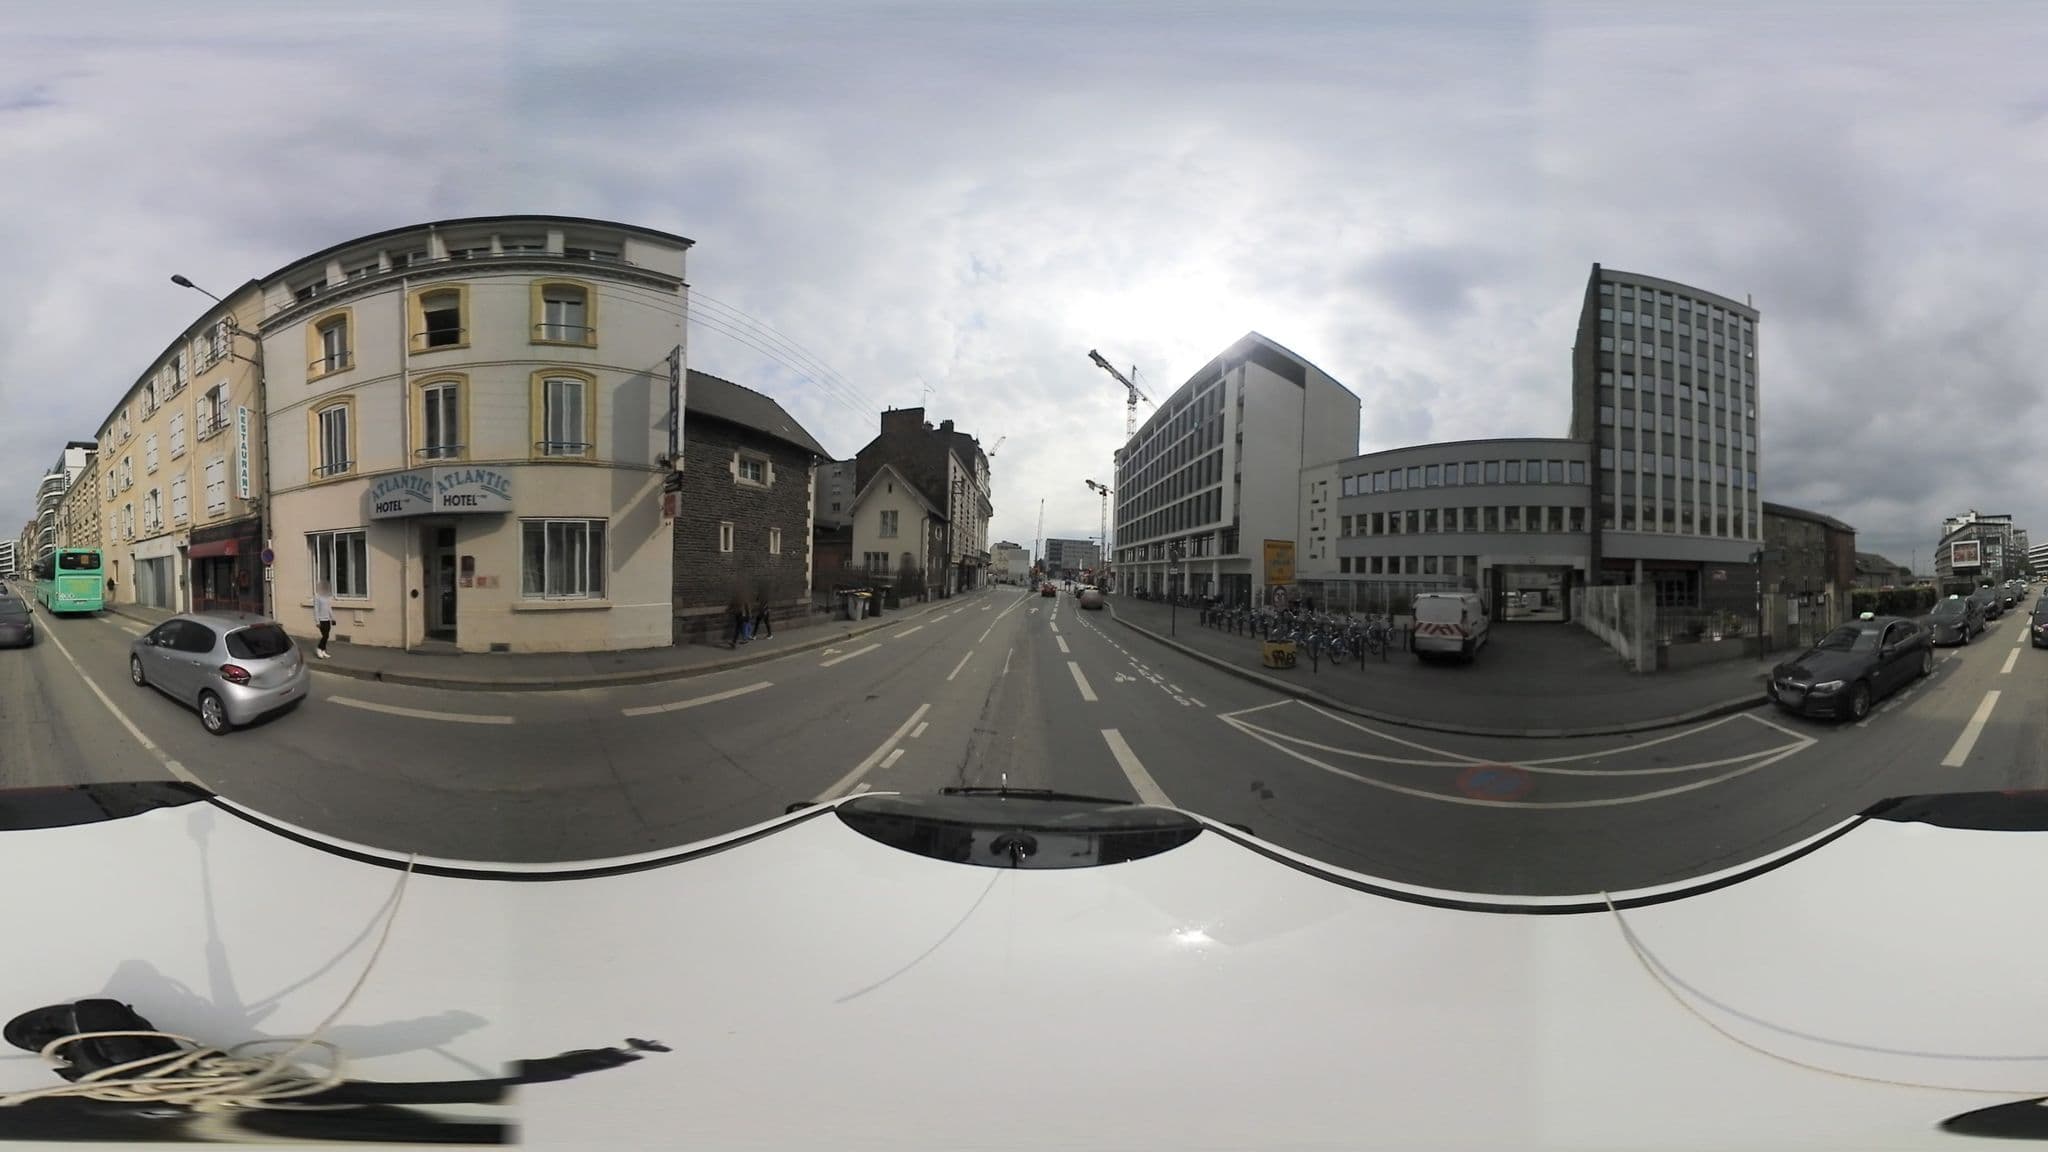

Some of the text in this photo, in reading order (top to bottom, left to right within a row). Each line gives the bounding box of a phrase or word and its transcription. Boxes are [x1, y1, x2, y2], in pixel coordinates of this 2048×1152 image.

[670, 349, 679, 456] HOTEL
[239, 407, 249, 497] RESTAURANT
[371, 474, 433, 502] ATLANTIC
[435, 469, 512, 494] ATLANTIC
[375, 499, 403, 513] HOTEL
[442, 494, 478, 507] HOTEL
